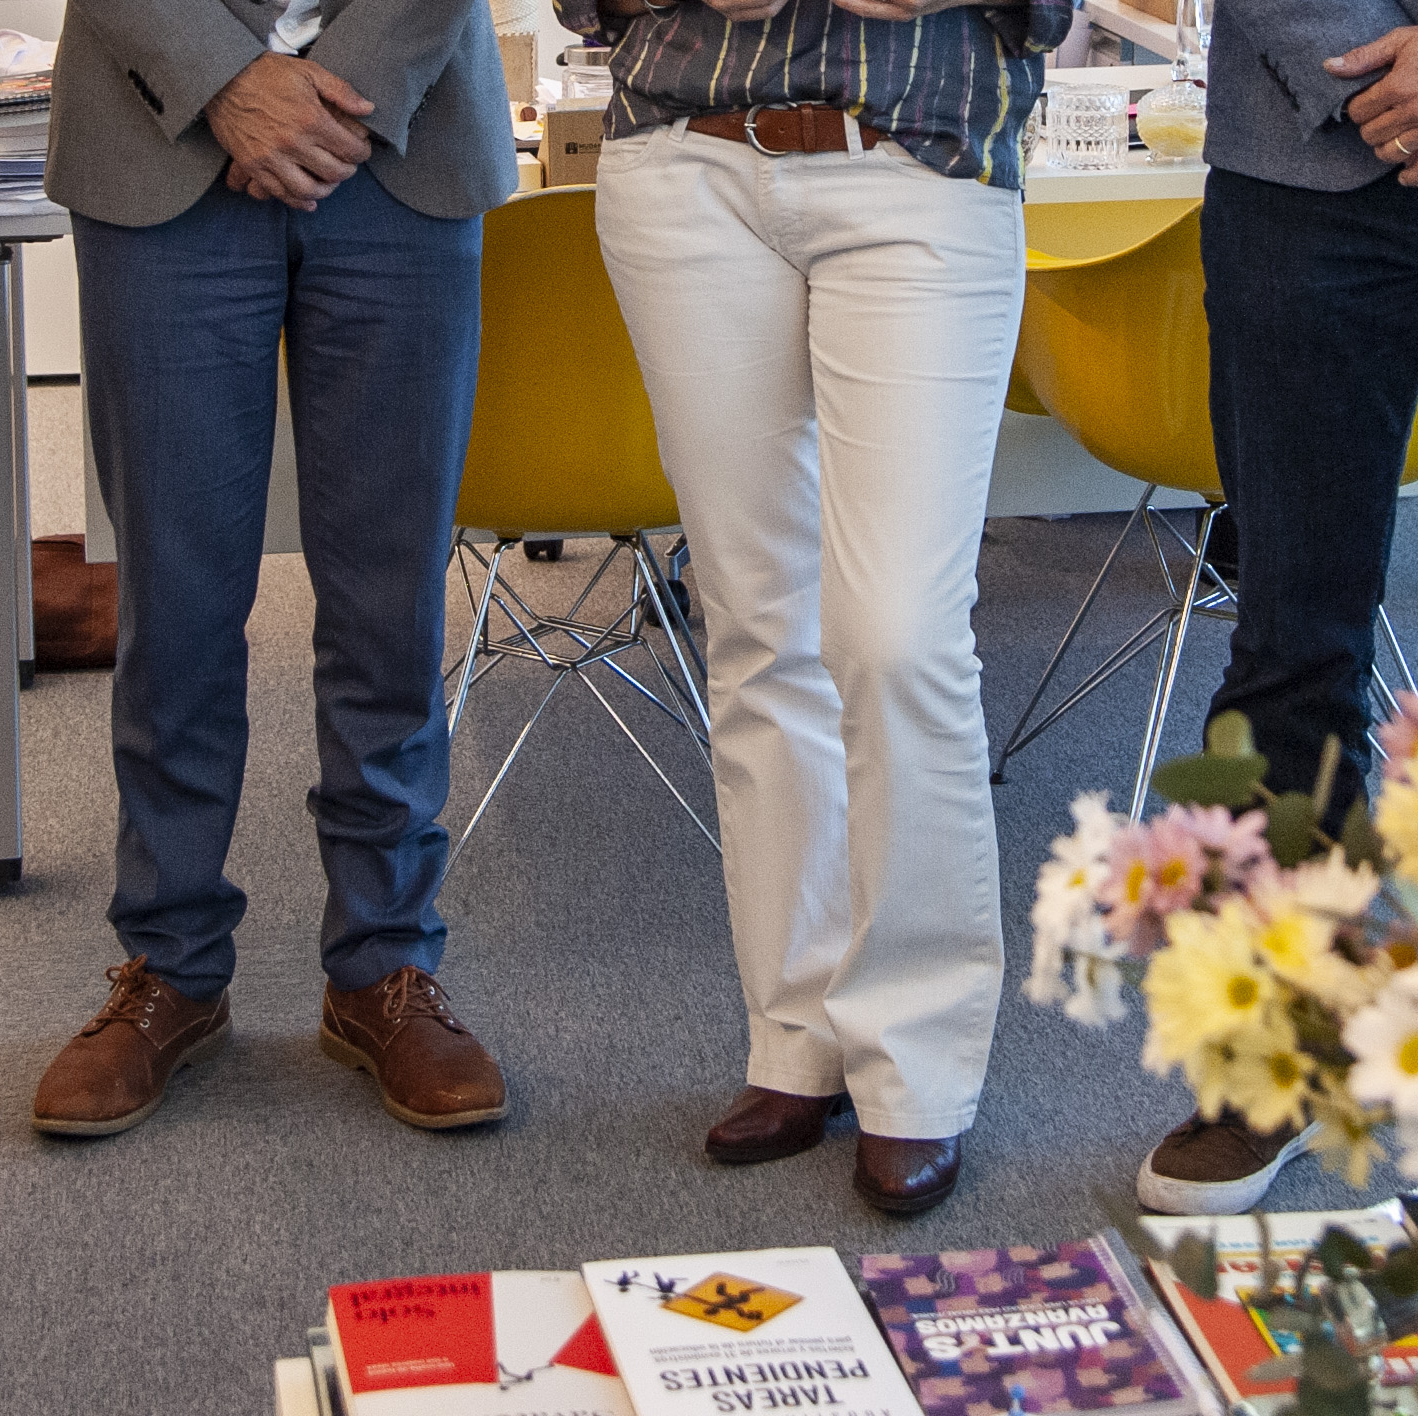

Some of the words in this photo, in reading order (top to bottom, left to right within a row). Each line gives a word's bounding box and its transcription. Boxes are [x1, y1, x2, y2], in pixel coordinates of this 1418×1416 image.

[913, 1303, 1110, 1335] AVANZAMOS
[659, 1357, 871, 1391] PENDIENTES
[711, 1383, 844, 1413] TAREAS
